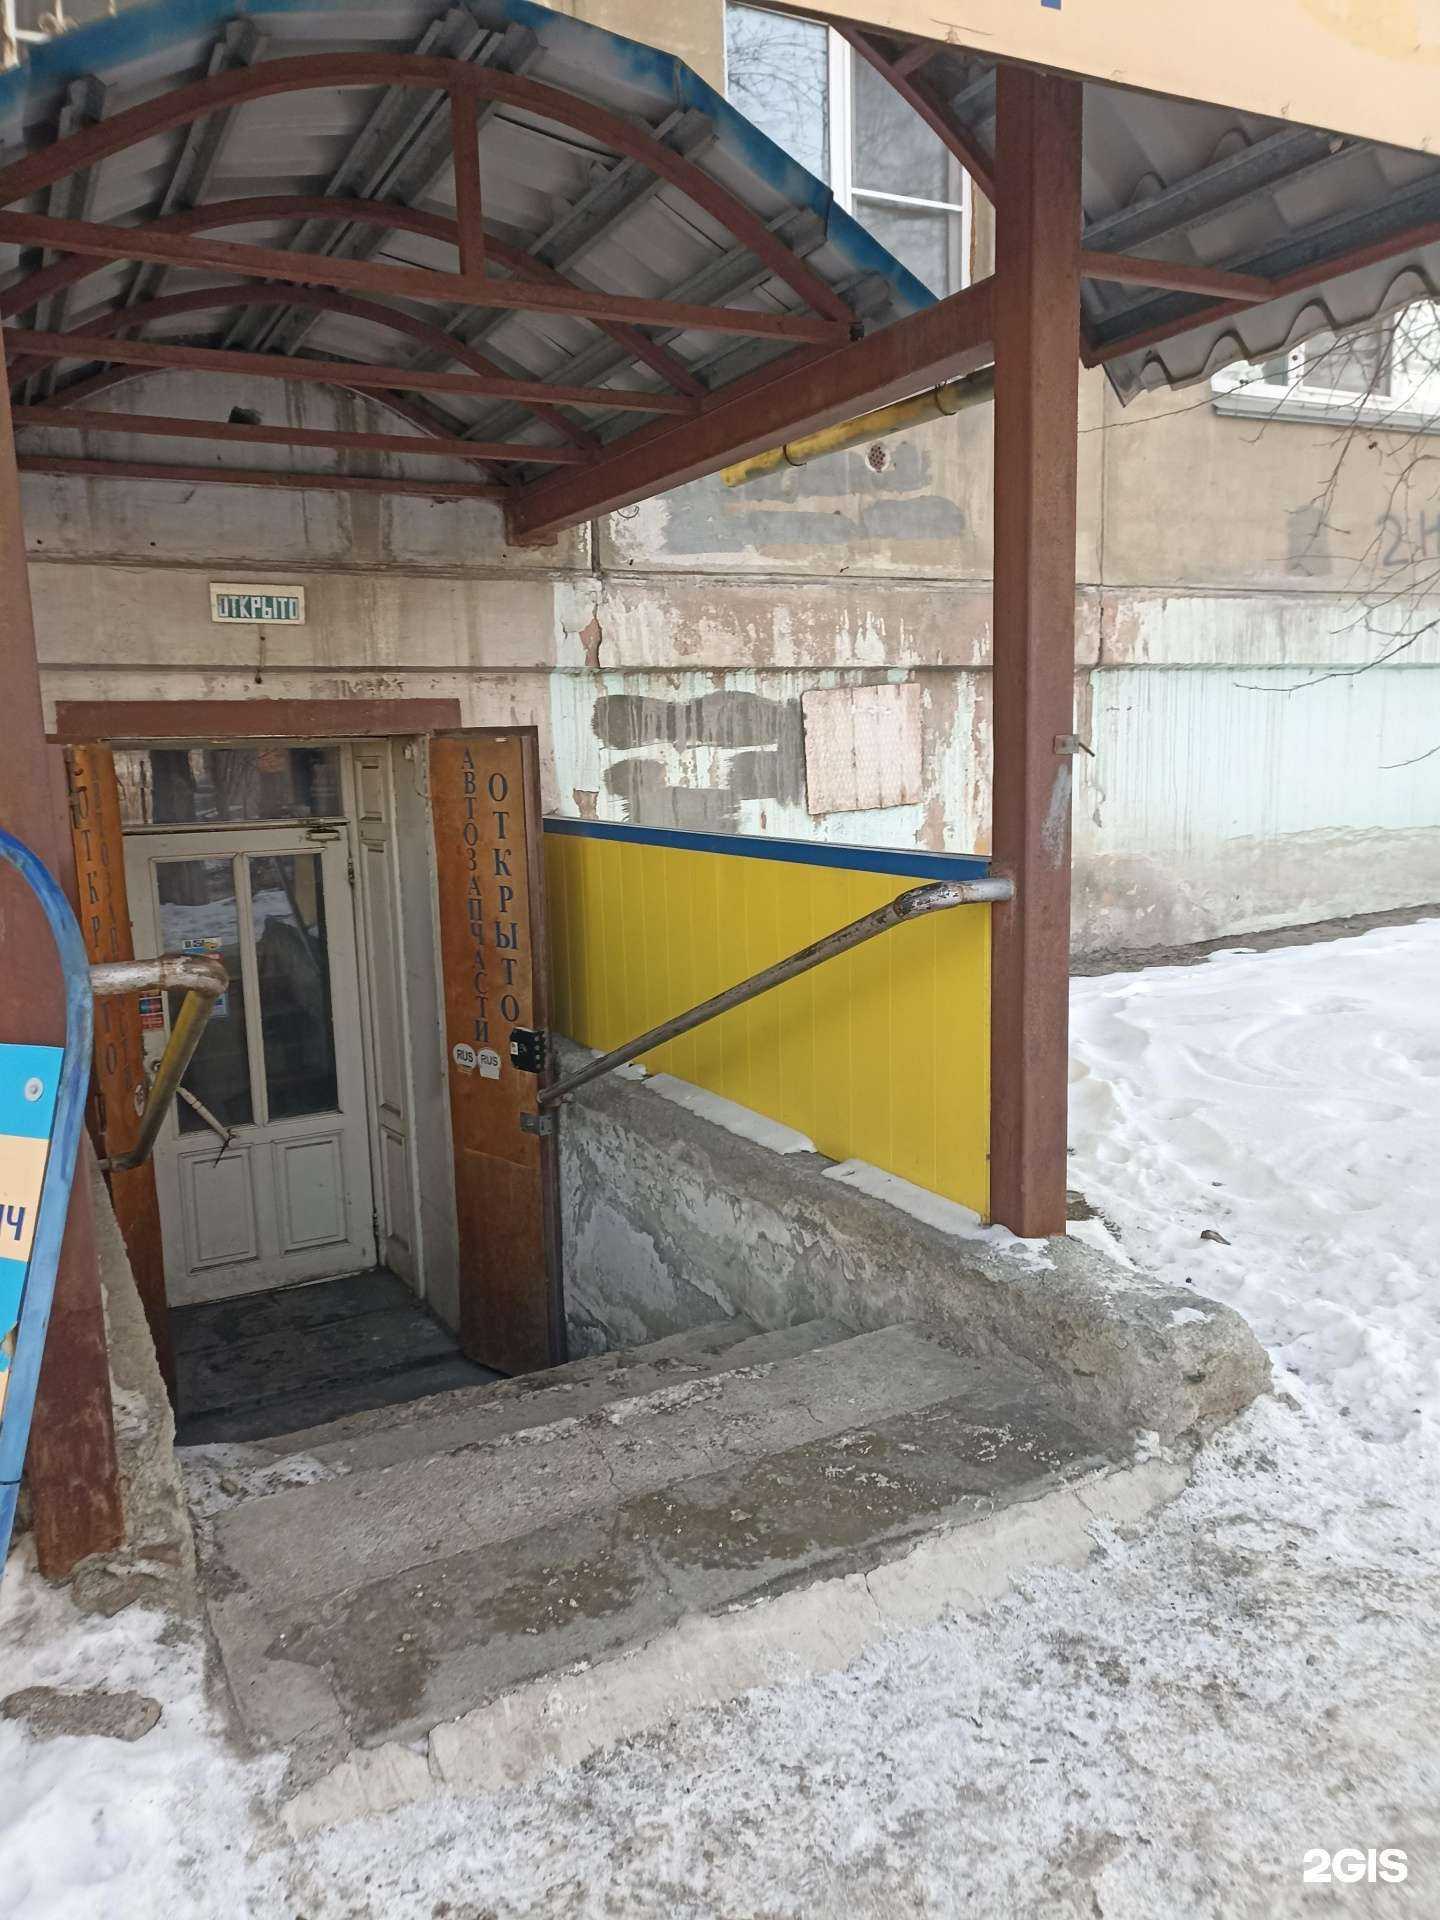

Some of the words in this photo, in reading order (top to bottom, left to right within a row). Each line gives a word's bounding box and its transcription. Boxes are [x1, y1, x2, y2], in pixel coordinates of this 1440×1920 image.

[218, 595, 299, 620] ОТКРЫТО
[76, 786, 117, 1075] ОТКРТО
[461, 746, 489, 1042] АВТОЗАПЧАСТИ
[488, 772, 520, 1023] ОТКРЫТО
[456, 1049, 474, 1063] RUS
[480, 1054, 499, 1067] RUS
